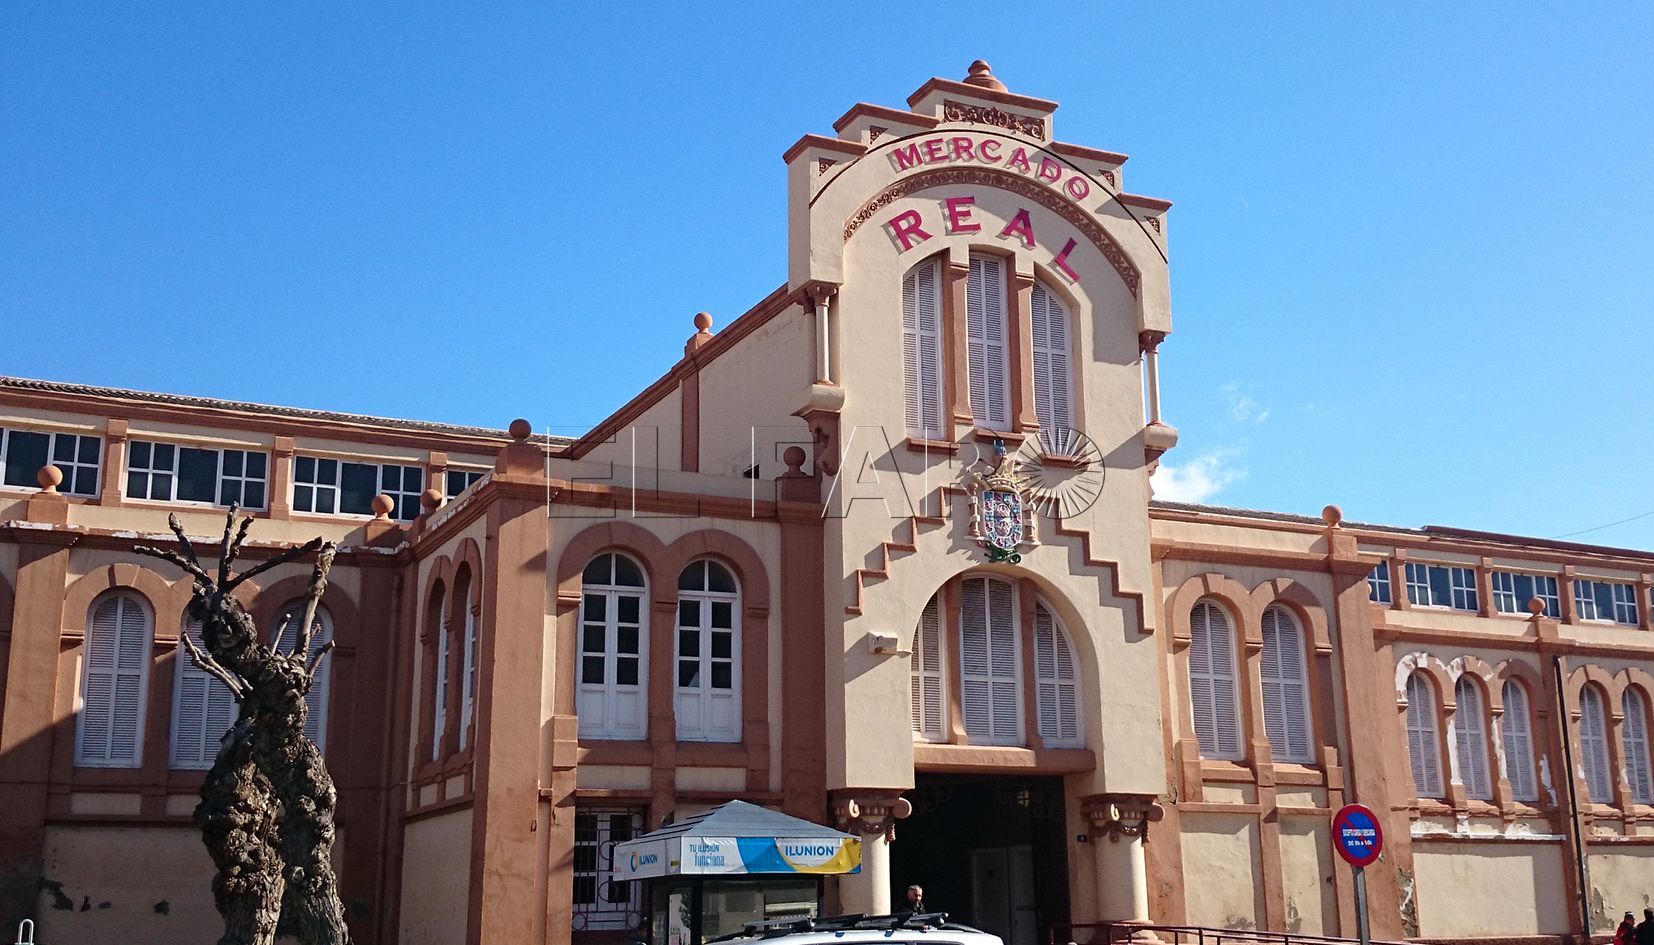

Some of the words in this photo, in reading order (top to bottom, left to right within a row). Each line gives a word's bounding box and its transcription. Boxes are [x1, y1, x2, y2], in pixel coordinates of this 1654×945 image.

[890, 136, 1090, 201] MERCADO
[886, 195, 1081, 284] REAL
[689, 844, 696, 852] TU
[785, 845, 835, 856] ILUNION
[638, 853, 658, 865] ILUNION
